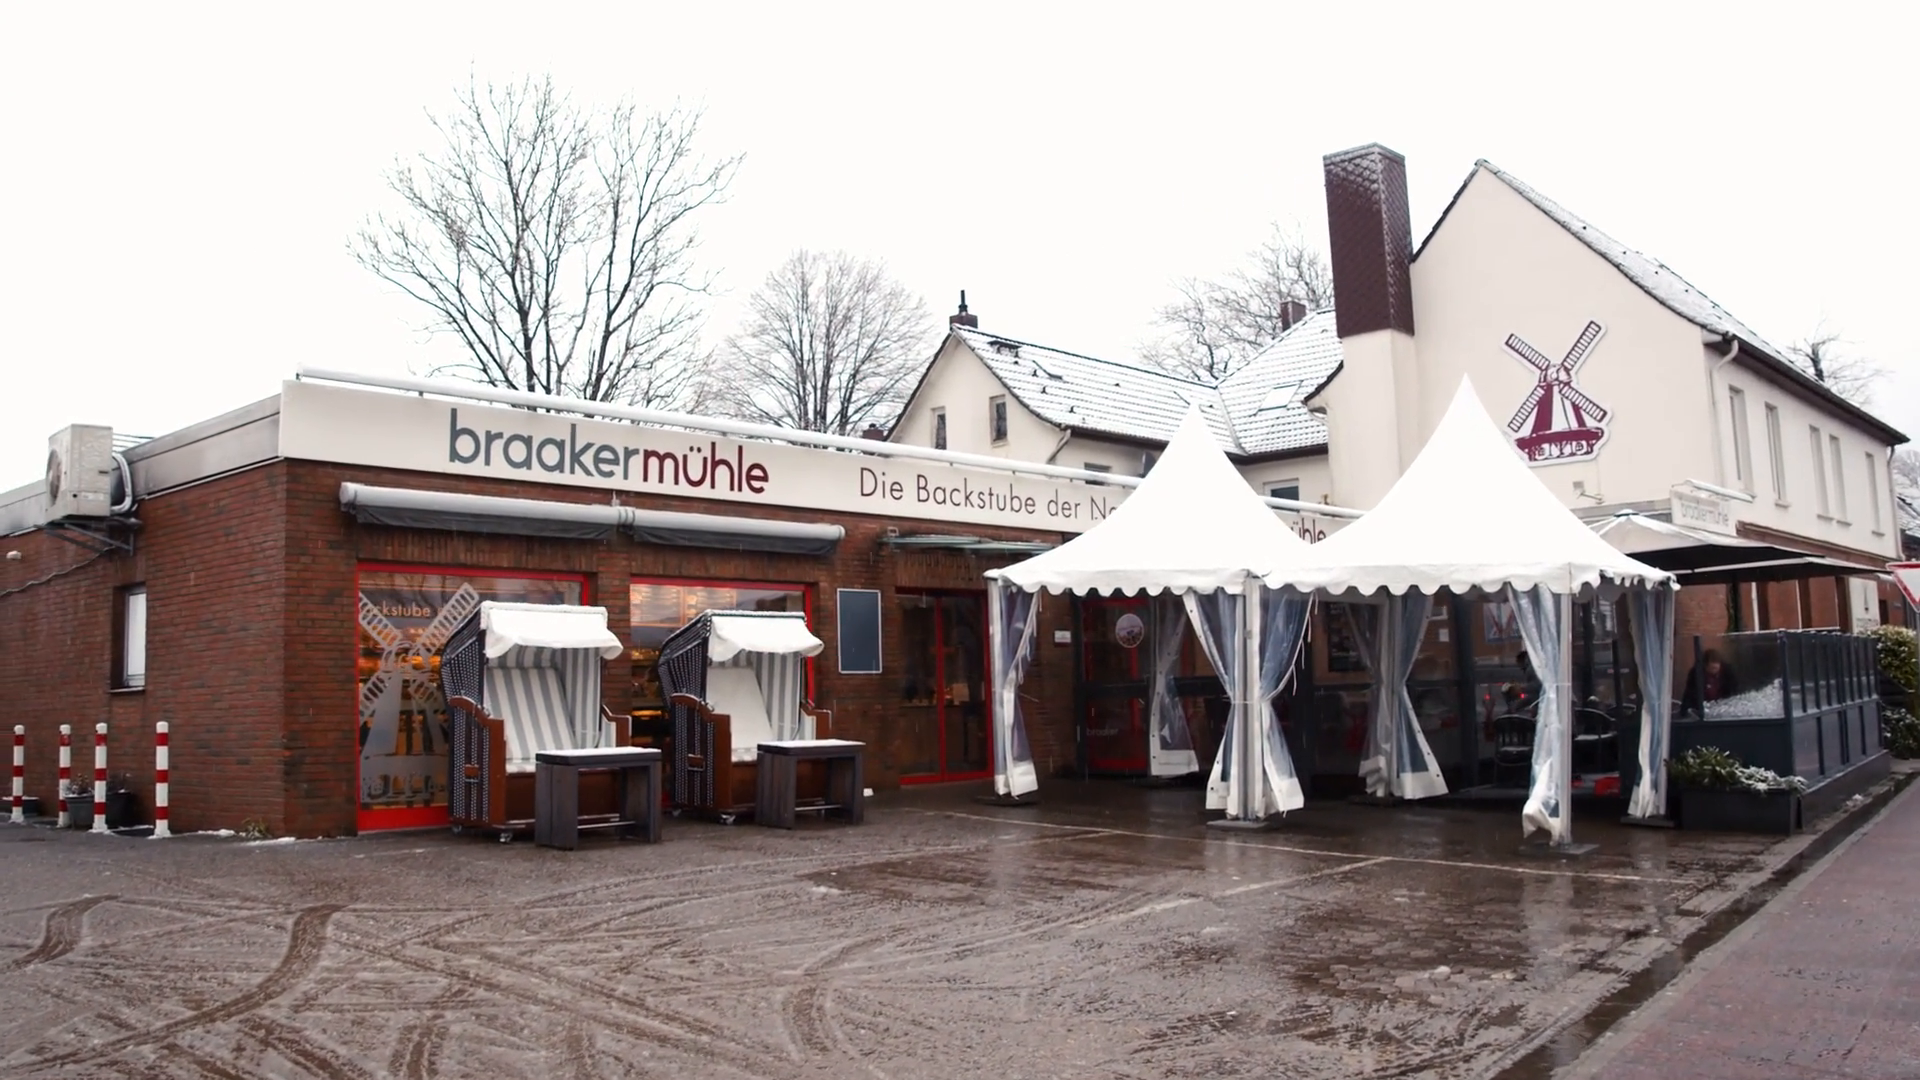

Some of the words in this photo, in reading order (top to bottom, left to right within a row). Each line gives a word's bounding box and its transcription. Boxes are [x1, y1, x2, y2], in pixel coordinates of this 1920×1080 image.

[449, 407, 769, 494] braakermühle
[860, 467, 904, 501] Die
[916, 474, 1036, 515] Backstube
[1046, 489, 1081, 521] der
